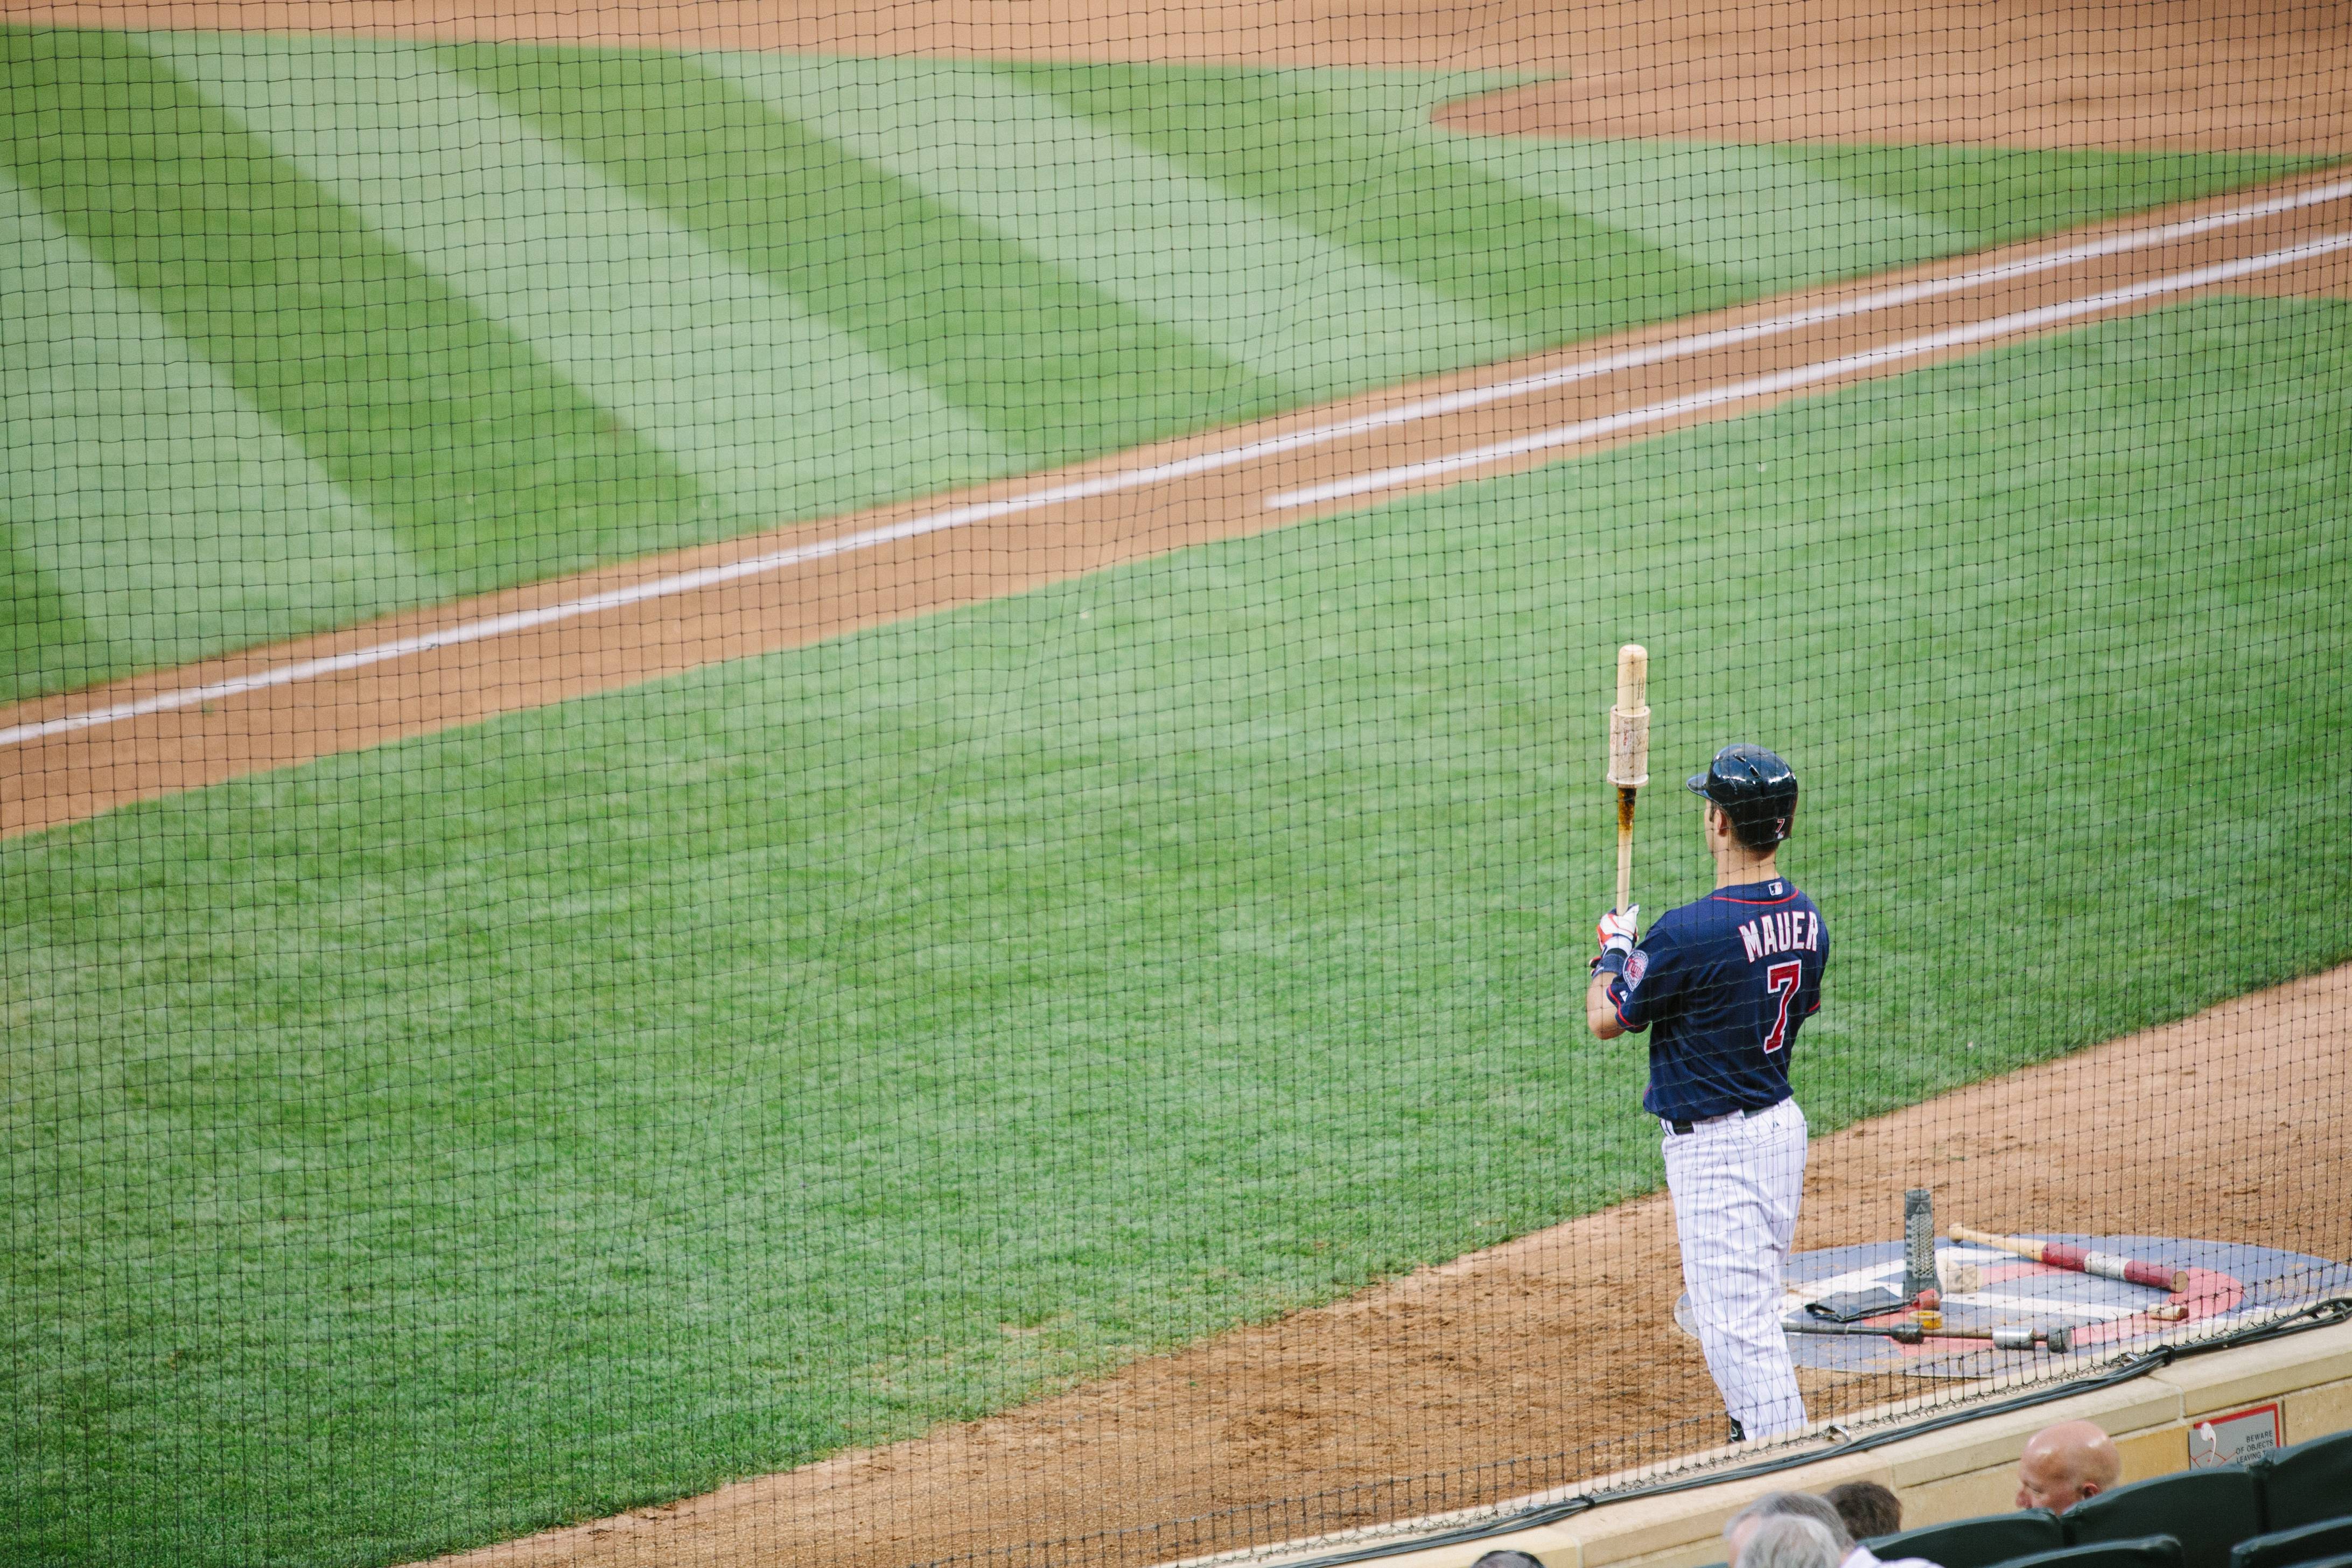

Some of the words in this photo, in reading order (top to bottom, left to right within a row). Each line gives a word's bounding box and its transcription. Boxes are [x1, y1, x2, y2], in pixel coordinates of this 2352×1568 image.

[1775, 818, 1785, 832] 7
[1738, 911, 1818, 963] MAUER
[1763, 959, 1802, 1054] 7
[2246, 1430, 2273, 1443] BEWARE
[2236, 1446, 2244, 1455] OF
[2247, 1439, 2273, 1452] OBJECTS
[2236, 1452, 2261, 1464] LEAVING
